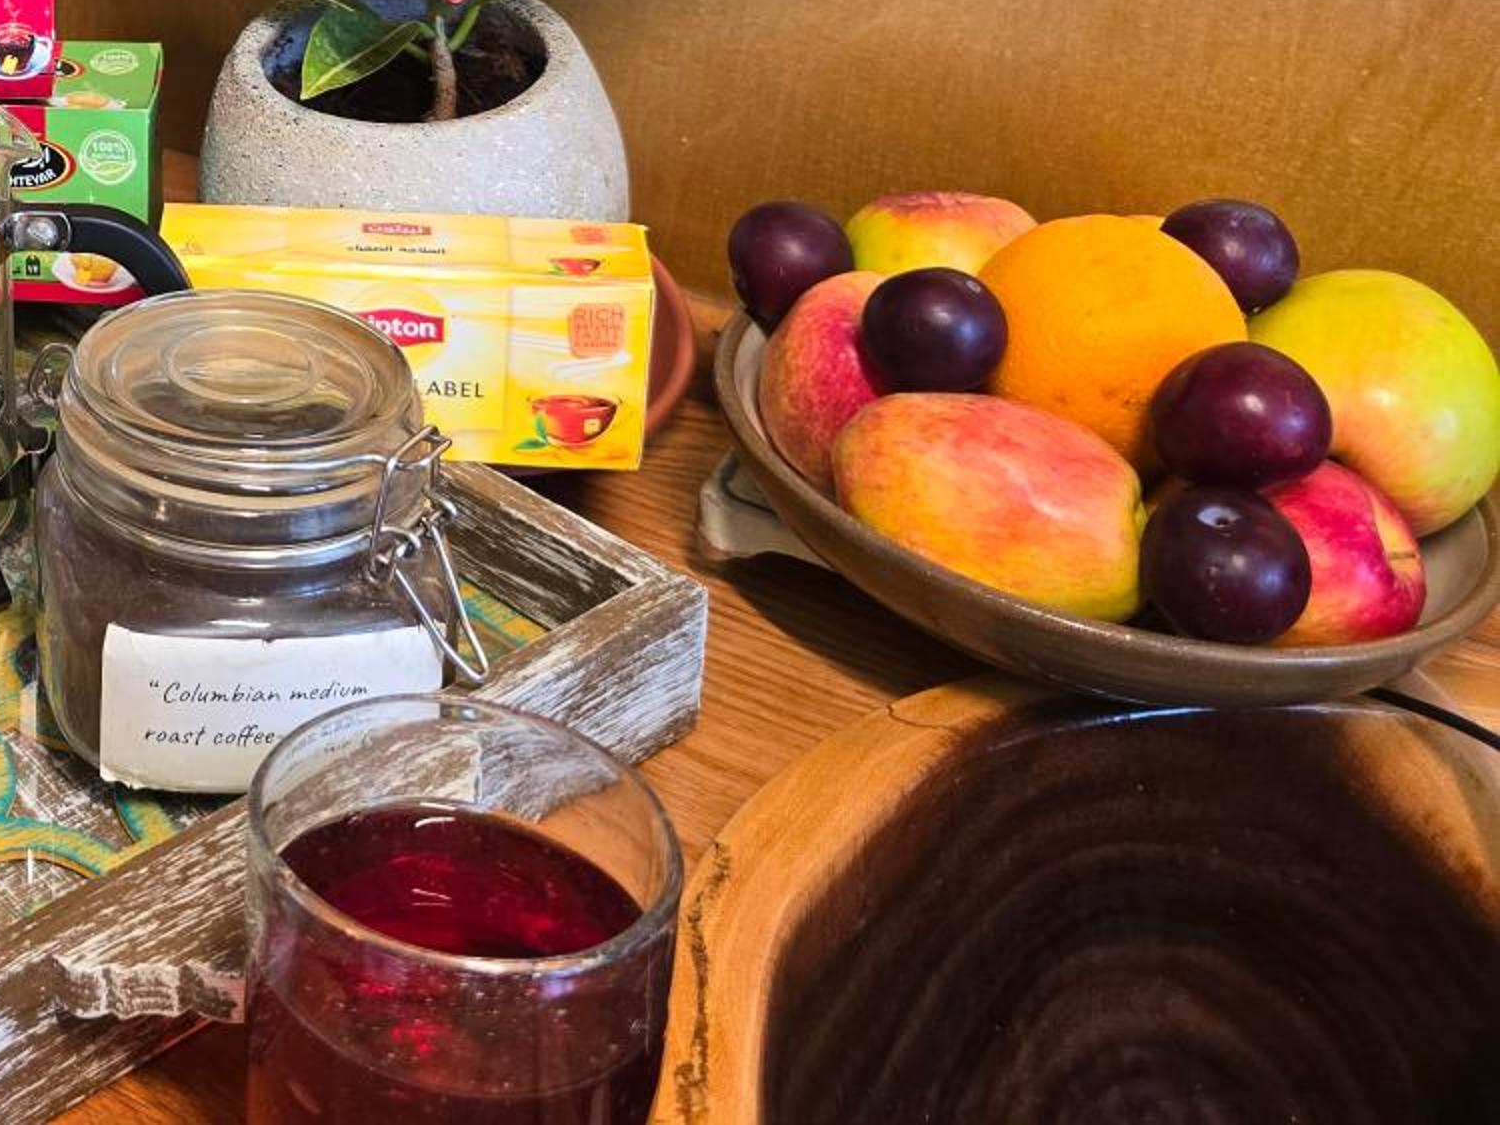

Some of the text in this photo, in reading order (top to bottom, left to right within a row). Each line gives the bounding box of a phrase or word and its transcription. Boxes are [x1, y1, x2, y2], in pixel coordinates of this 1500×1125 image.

[574, 308, 622, 322] RICH
[365, 315, 436, 338] ipton
[289, 681, 370, 703] medium
[144, 725, 276, 748] roast coffee
